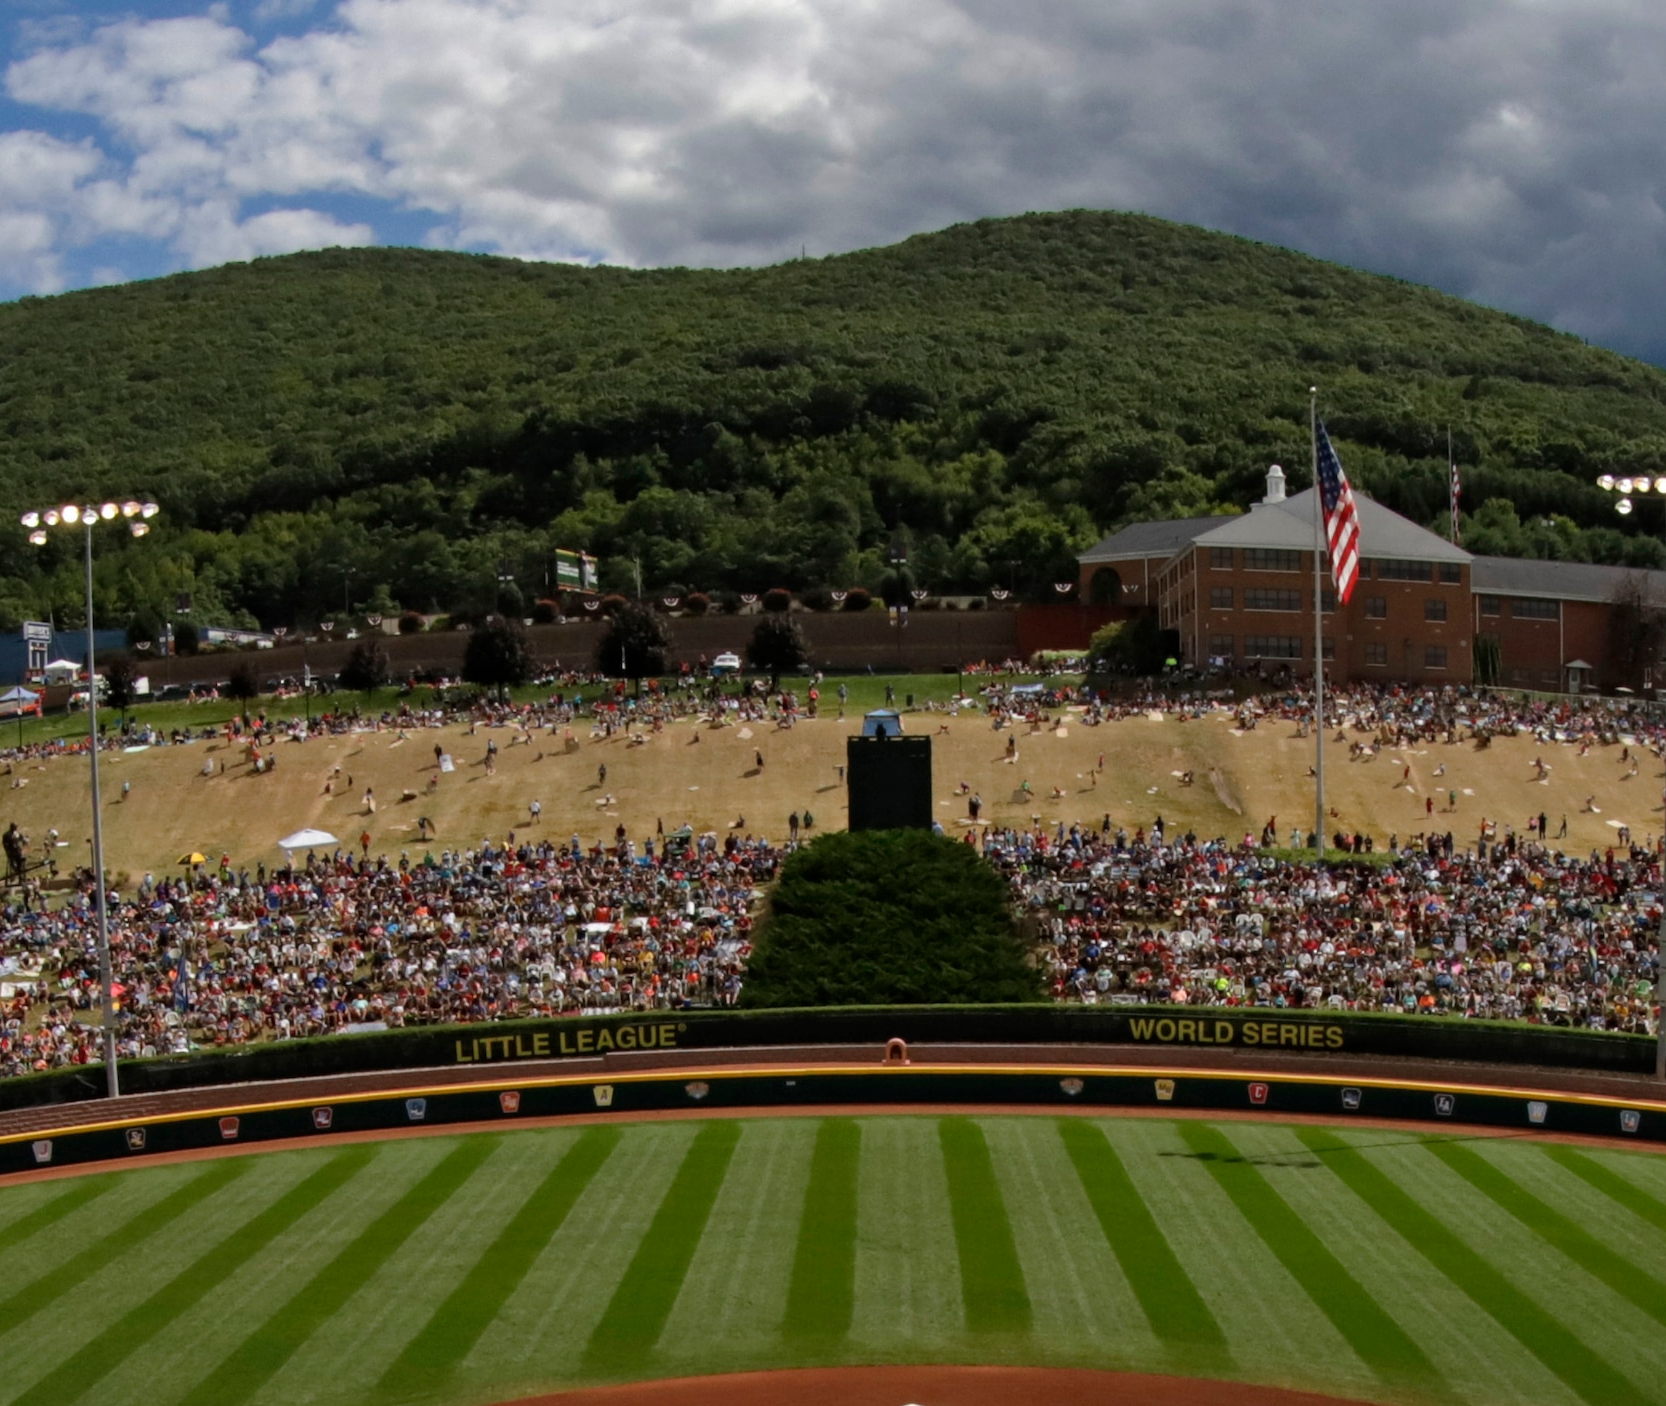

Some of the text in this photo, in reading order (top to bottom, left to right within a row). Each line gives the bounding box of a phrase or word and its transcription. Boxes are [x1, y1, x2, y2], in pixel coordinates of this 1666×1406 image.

[455, 1033, 551, 1062] LITTLE
[1128, 1018, 1344, 1048] WORLD SERIES
